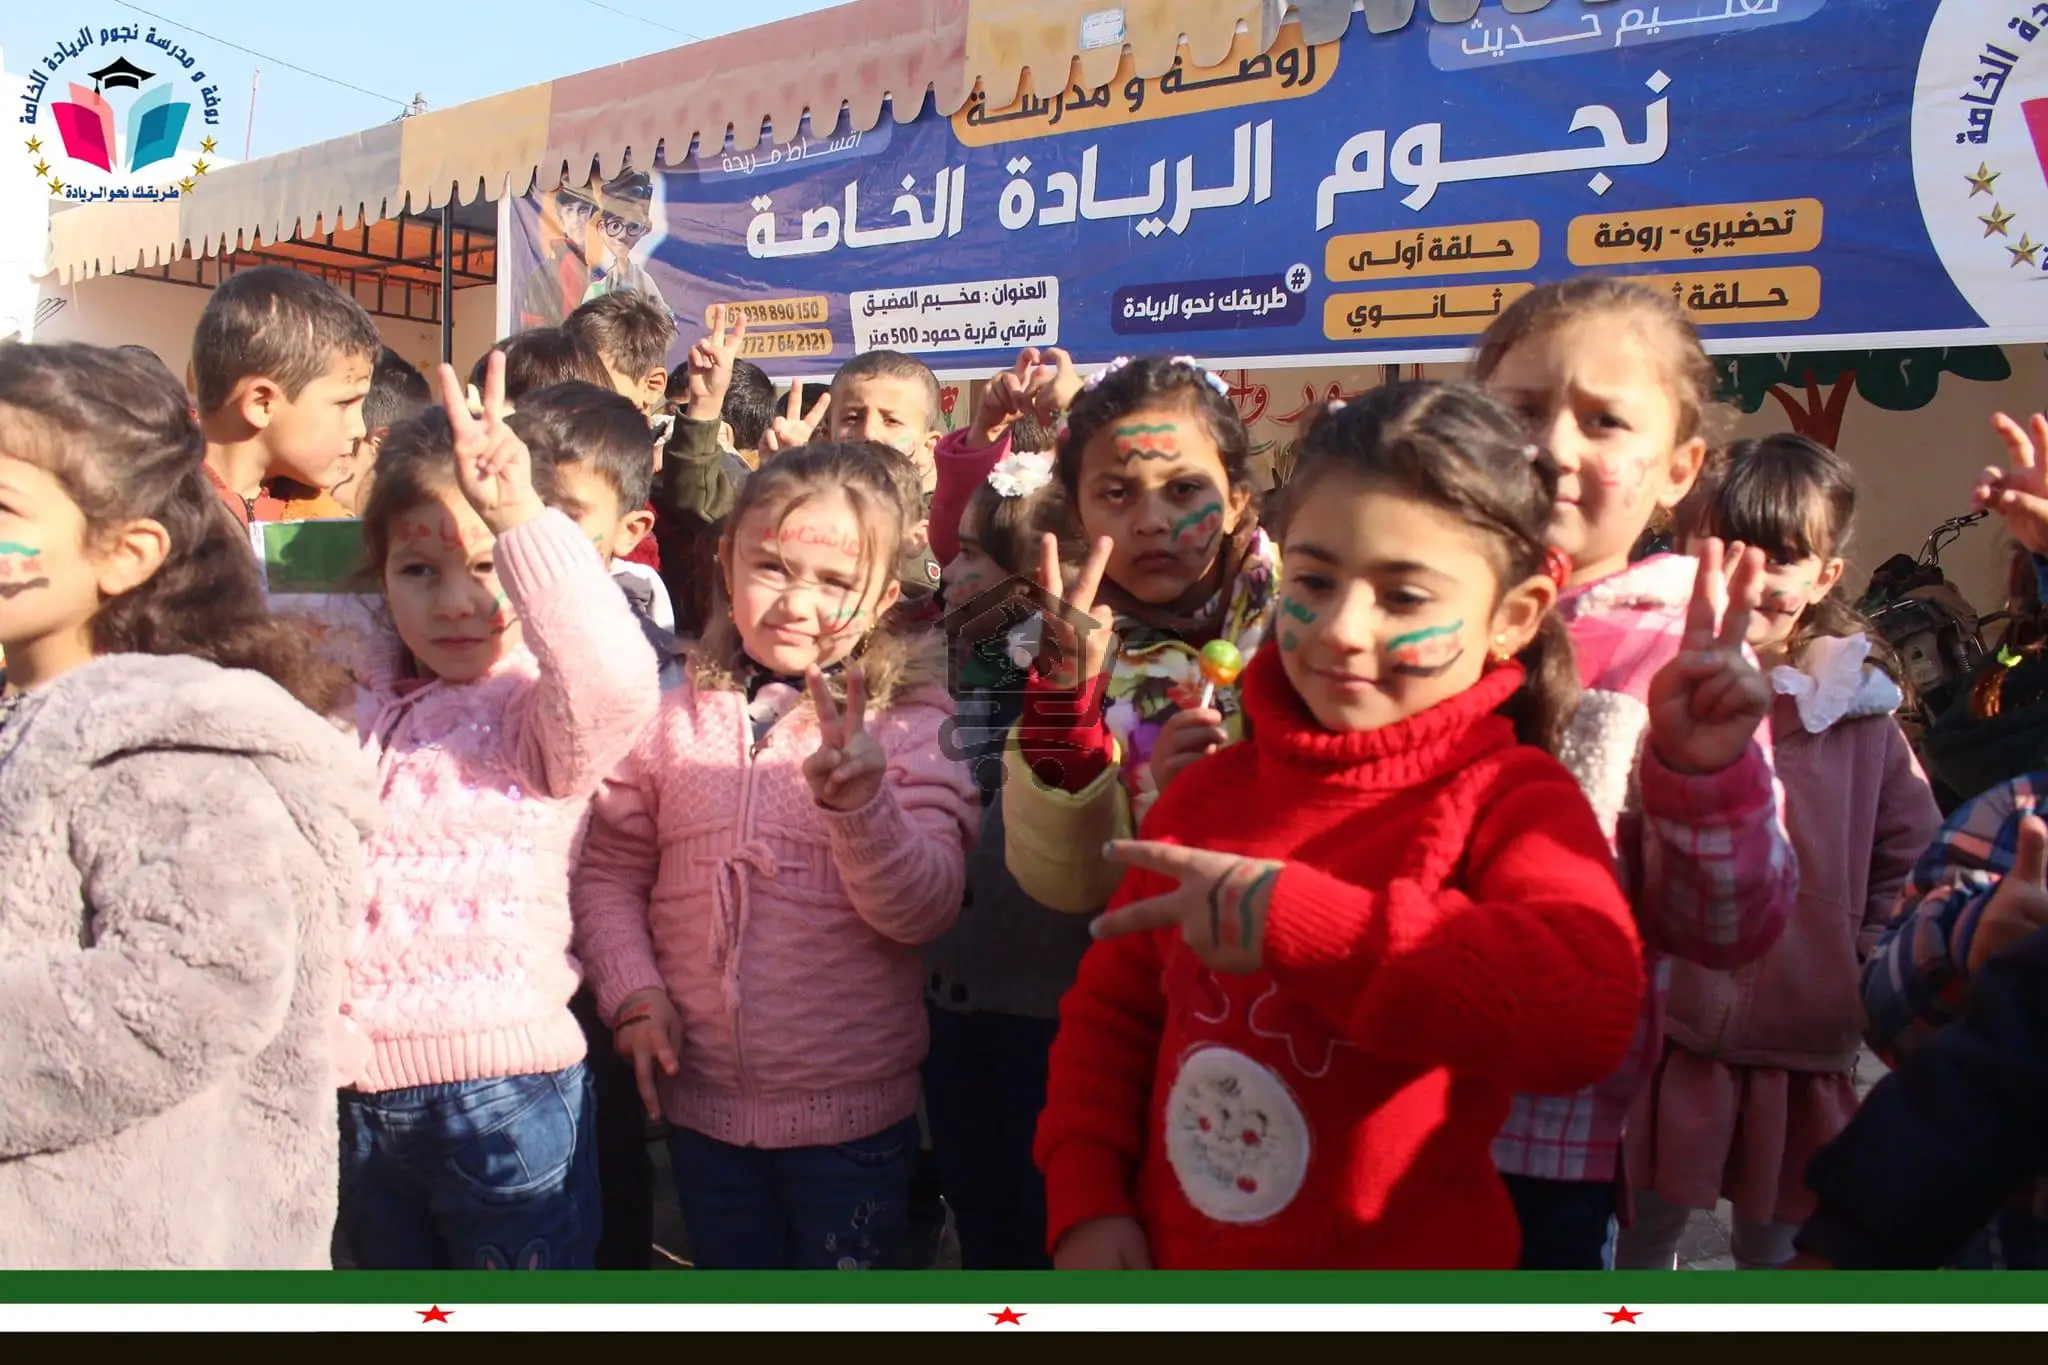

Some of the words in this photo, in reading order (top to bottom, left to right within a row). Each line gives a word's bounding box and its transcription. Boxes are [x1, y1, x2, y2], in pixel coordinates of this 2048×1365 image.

[1462, 13, 1602, 57] حديث
[1124, 76, 1145, 113] و
[1956, 43, 2019, 144] الخاصة
[722, 149, 781, 175] مريحة
[1315, 69, 1672, 232] نجوم
[998, 118, 1273, 239] الريادة
[746, 163, 966, 259] الخاصة
[1594, 221, 1663, 253] روضة
[1685, 208, 1797, 254] تحضيري
[1349, 233, 1424, 271] أولى
[1428, 234, 1514, 262] حلقة
[862, 290, 918, 317] المضيق
[921, 287, 981, 314] مخيم
[991, 280, 1047, 306] العنوان
[1123, 293, 1180, 322] الريادة
[1181, 291, 1215, 320] نحو
[1218, 286, 1288, 315] طريقك
[1687, 281, 1789, 311] حلقة
[768, 303, 795, 321] 890
[797, 301, 819, 320] 150
[1346, 287, 1503, 333] ثانوي
[796, 332, 826, 351] 2121
[868, 330, 889, 350] متر
[891, 327, 919, 344] 500
[921, 326, 961, 347] حمود
[965, 321, 997, 345] قرية
[1000, 315, 1047, 346] شرقي
